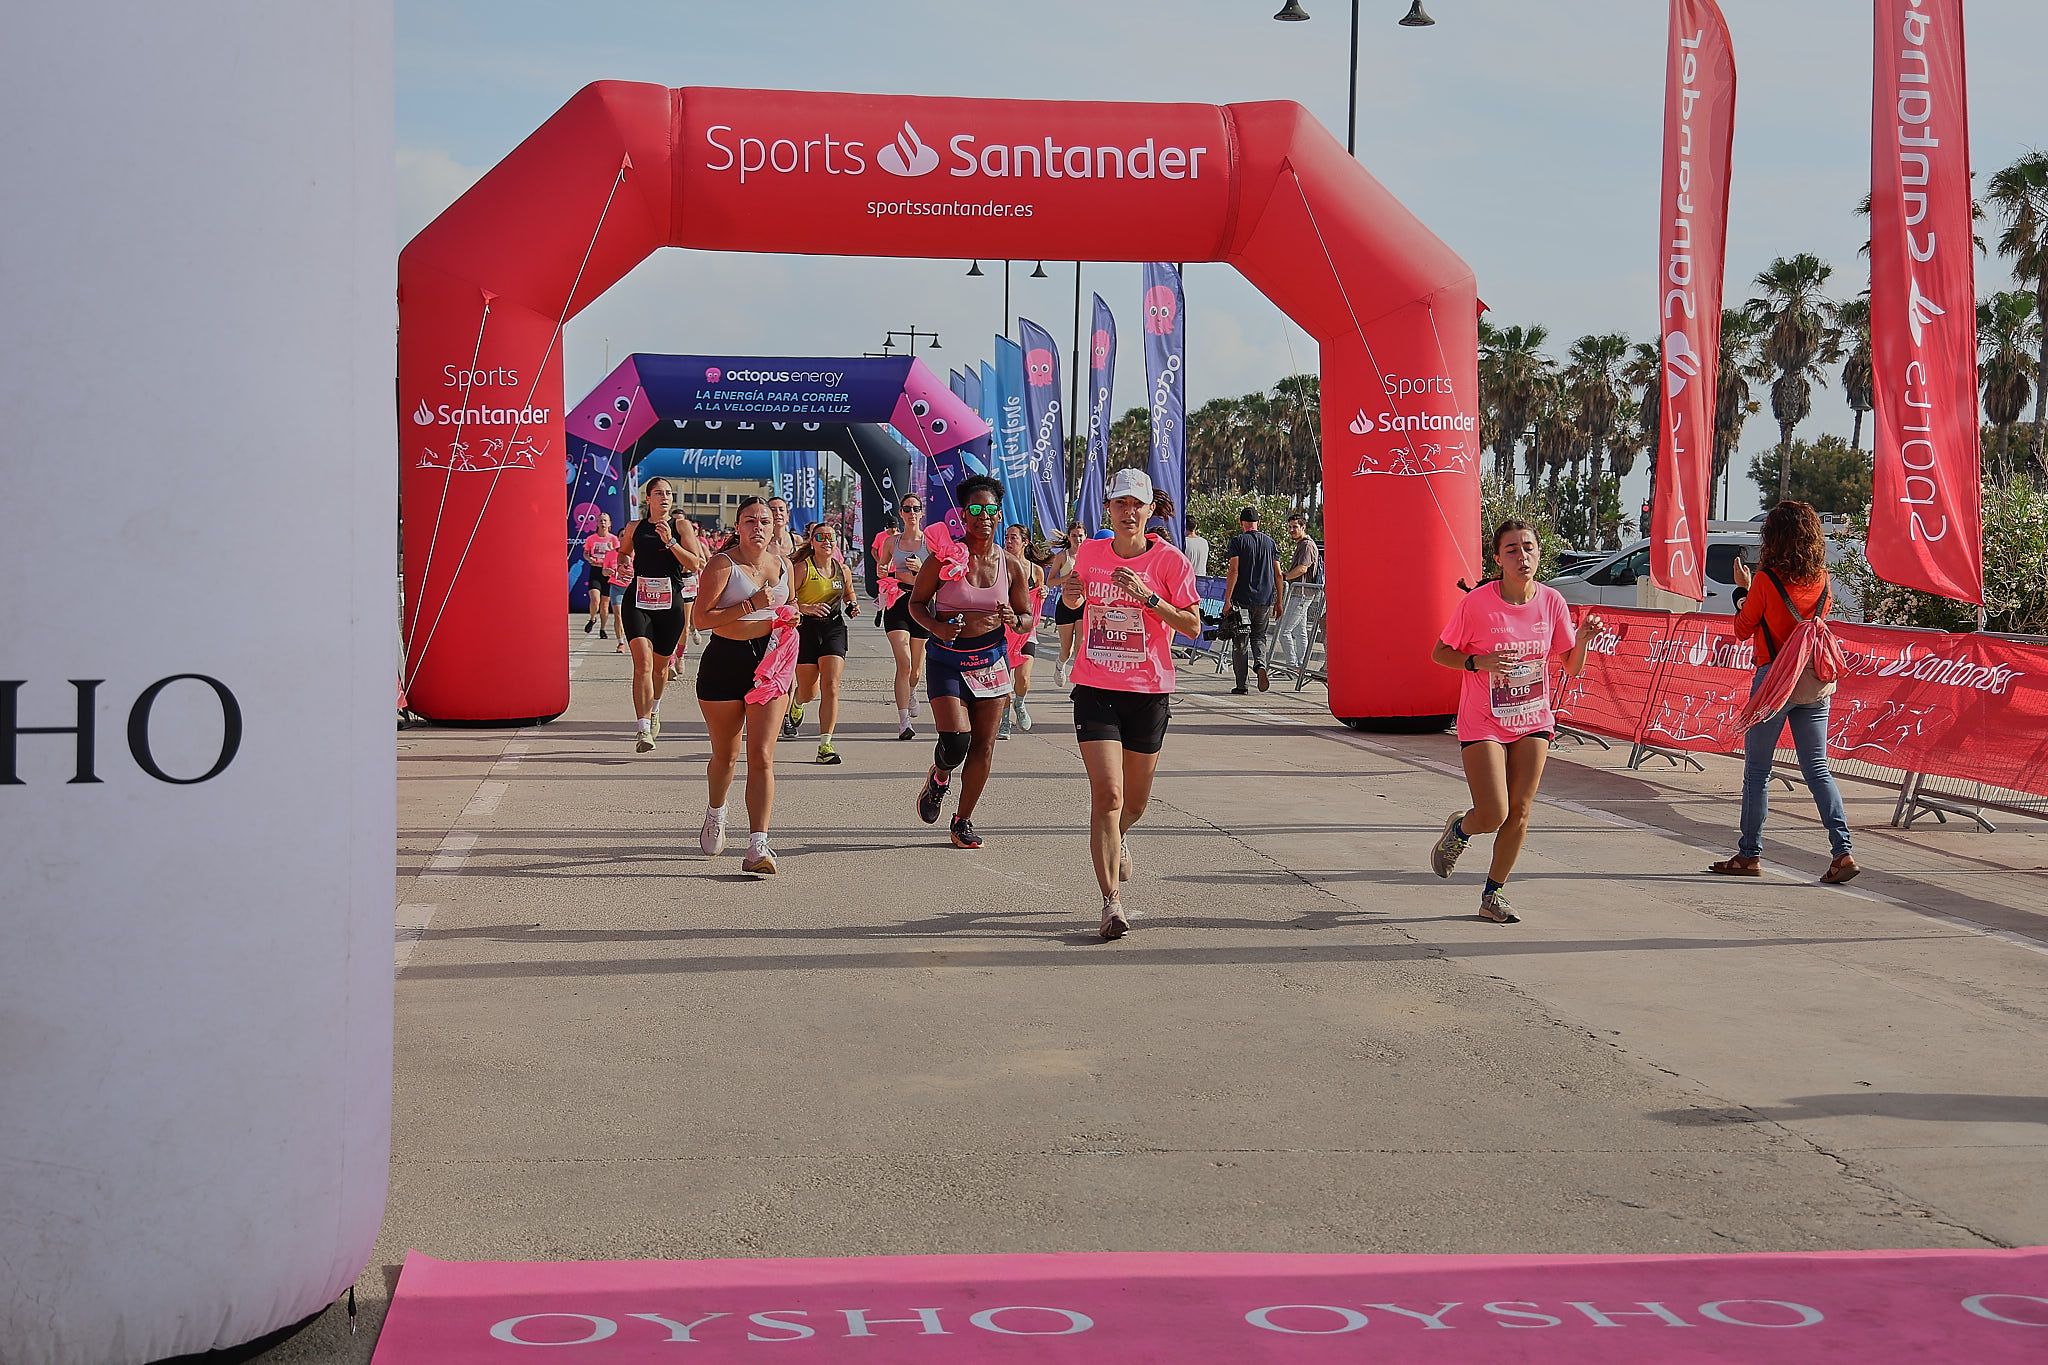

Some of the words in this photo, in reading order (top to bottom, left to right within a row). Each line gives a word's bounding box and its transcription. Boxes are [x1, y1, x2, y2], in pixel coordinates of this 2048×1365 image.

[706, 125, 866, 184] Sports
[949, 134, 1207, 180] Santander
[867, 199, 1034, 218] sportssantander.es
[443, 364, 518, 391] Sports
[726, 369, 789, 385] octopus
[791, 371, 844, 387] energy
[1384, 373, 1453, 400] Sports
[695, 390, 711, 400] LA
[713, 389, 765, 401] ENERGÍA
[766, 392, 799, 402] PARA
[801, 393, 849, 402] CORRER
[437, 404, 550, 425] Santander
[694, 402, 703, 410] A
[705, 403, 721, 411] LA
[723, 403, 791, 412] VELOCIDAD
[792, 404, 808, 413] DE
[810, 405, 825, 413] LA
[828, 405, 851, 413] LUZ
[1378, 411, 1475, 432] Santander
[682, 448, 743, 474] Marlene
[1088, 581, 1142, 603] CARRE
[1106, 630, 1128, 641] 016
[1644, 630, 1689, 671] Sports
[1707, 635, 1755, 670] Santa
[979, 672, 997, 683] 016
[1901, 652, 2025, 695] Santander
[1510, 685, 1531, 696] 016
[0, 673, 242, 785] HO
[490, 1305, 1095, 1346] OYSHO
[1244, 1299, 1825, 1335] OYSHO
